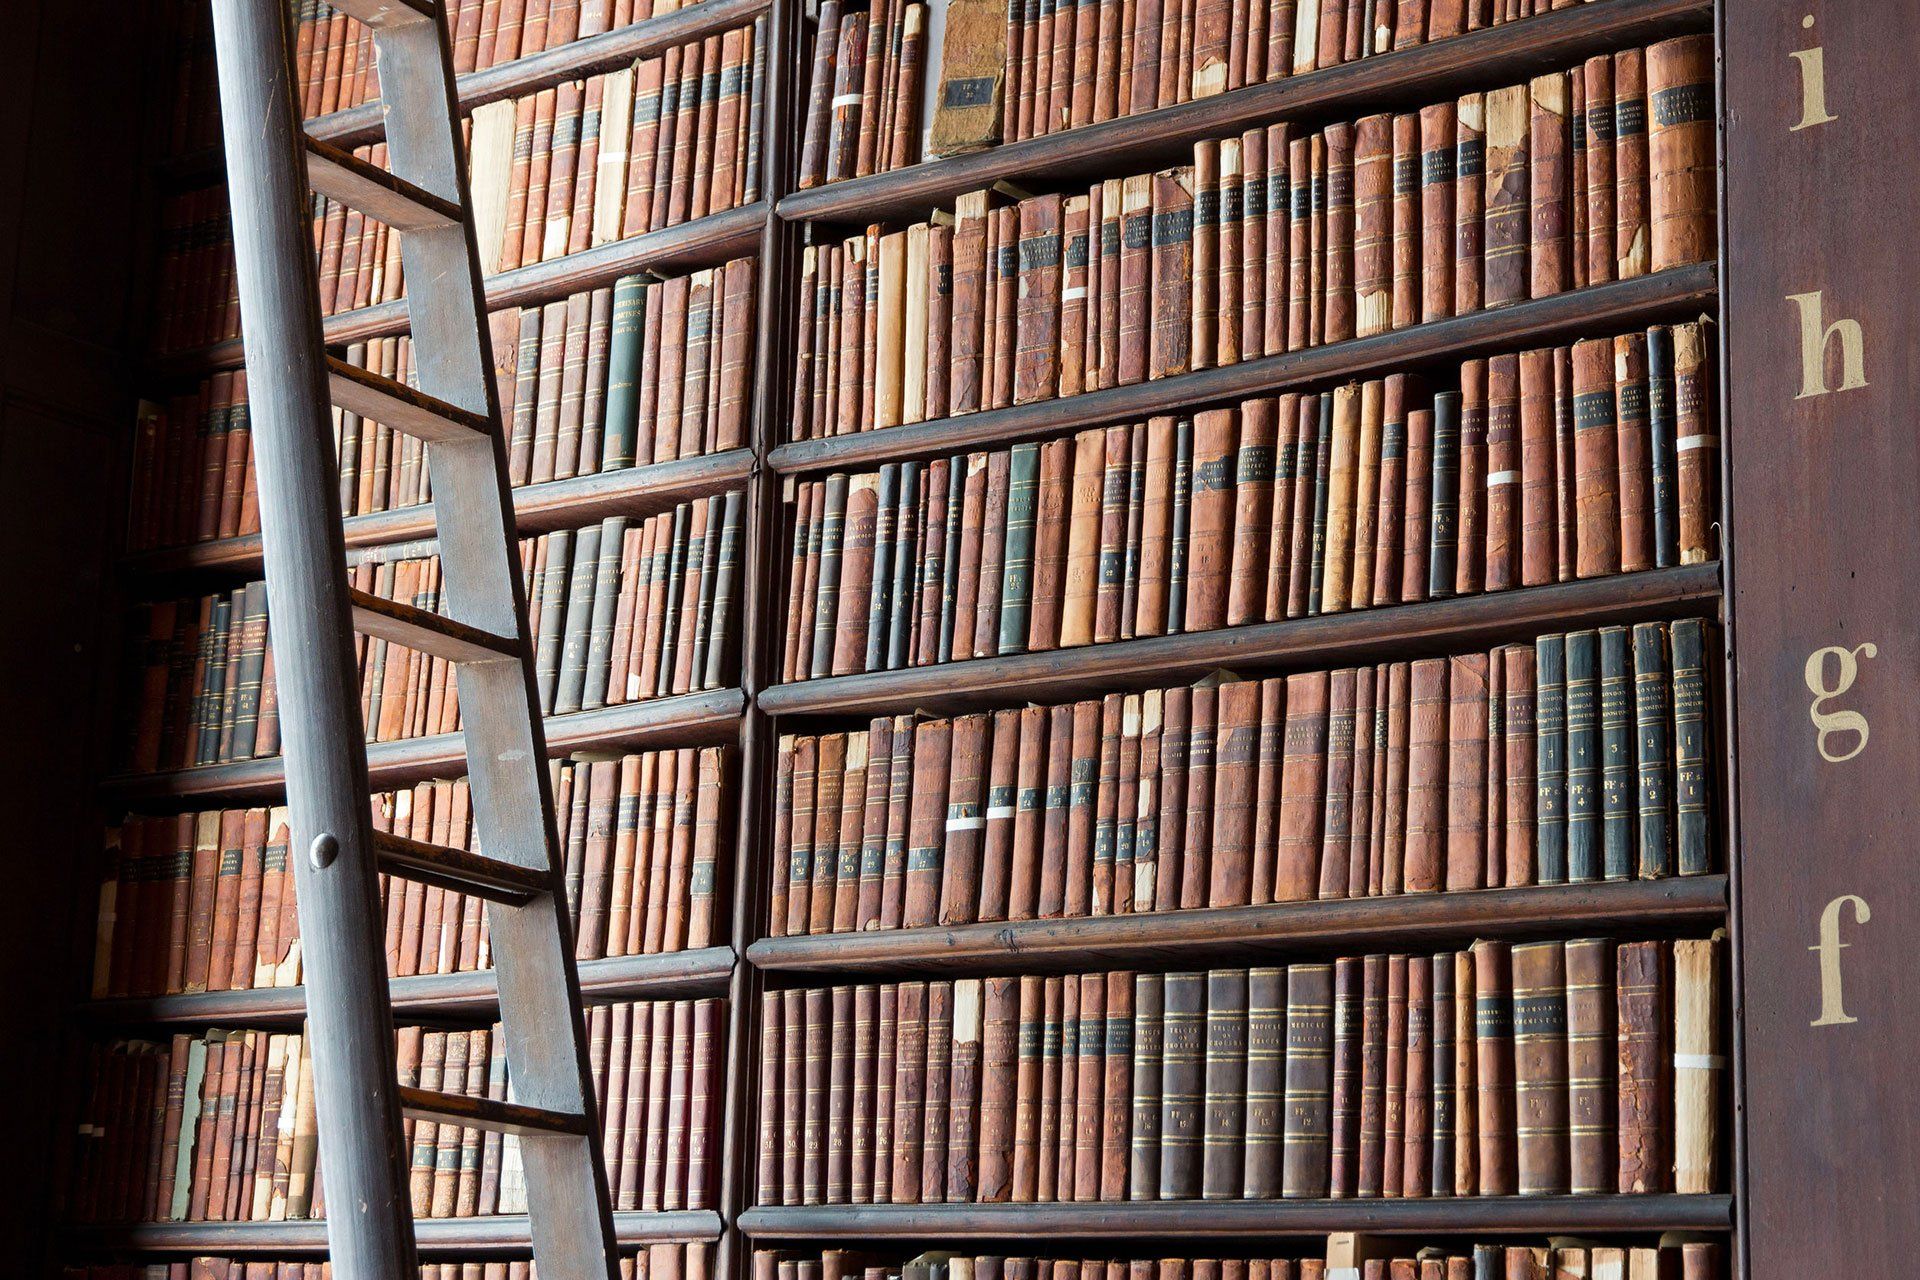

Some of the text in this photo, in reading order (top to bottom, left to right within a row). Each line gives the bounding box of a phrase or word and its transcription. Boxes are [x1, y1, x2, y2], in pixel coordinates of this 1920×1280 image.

[1788, 14, 1839, 131] i
[1785, 290, 1871, 399] h
[1805, 642, 1878, 763] g
[1808, 894, 1871, 1027] f
